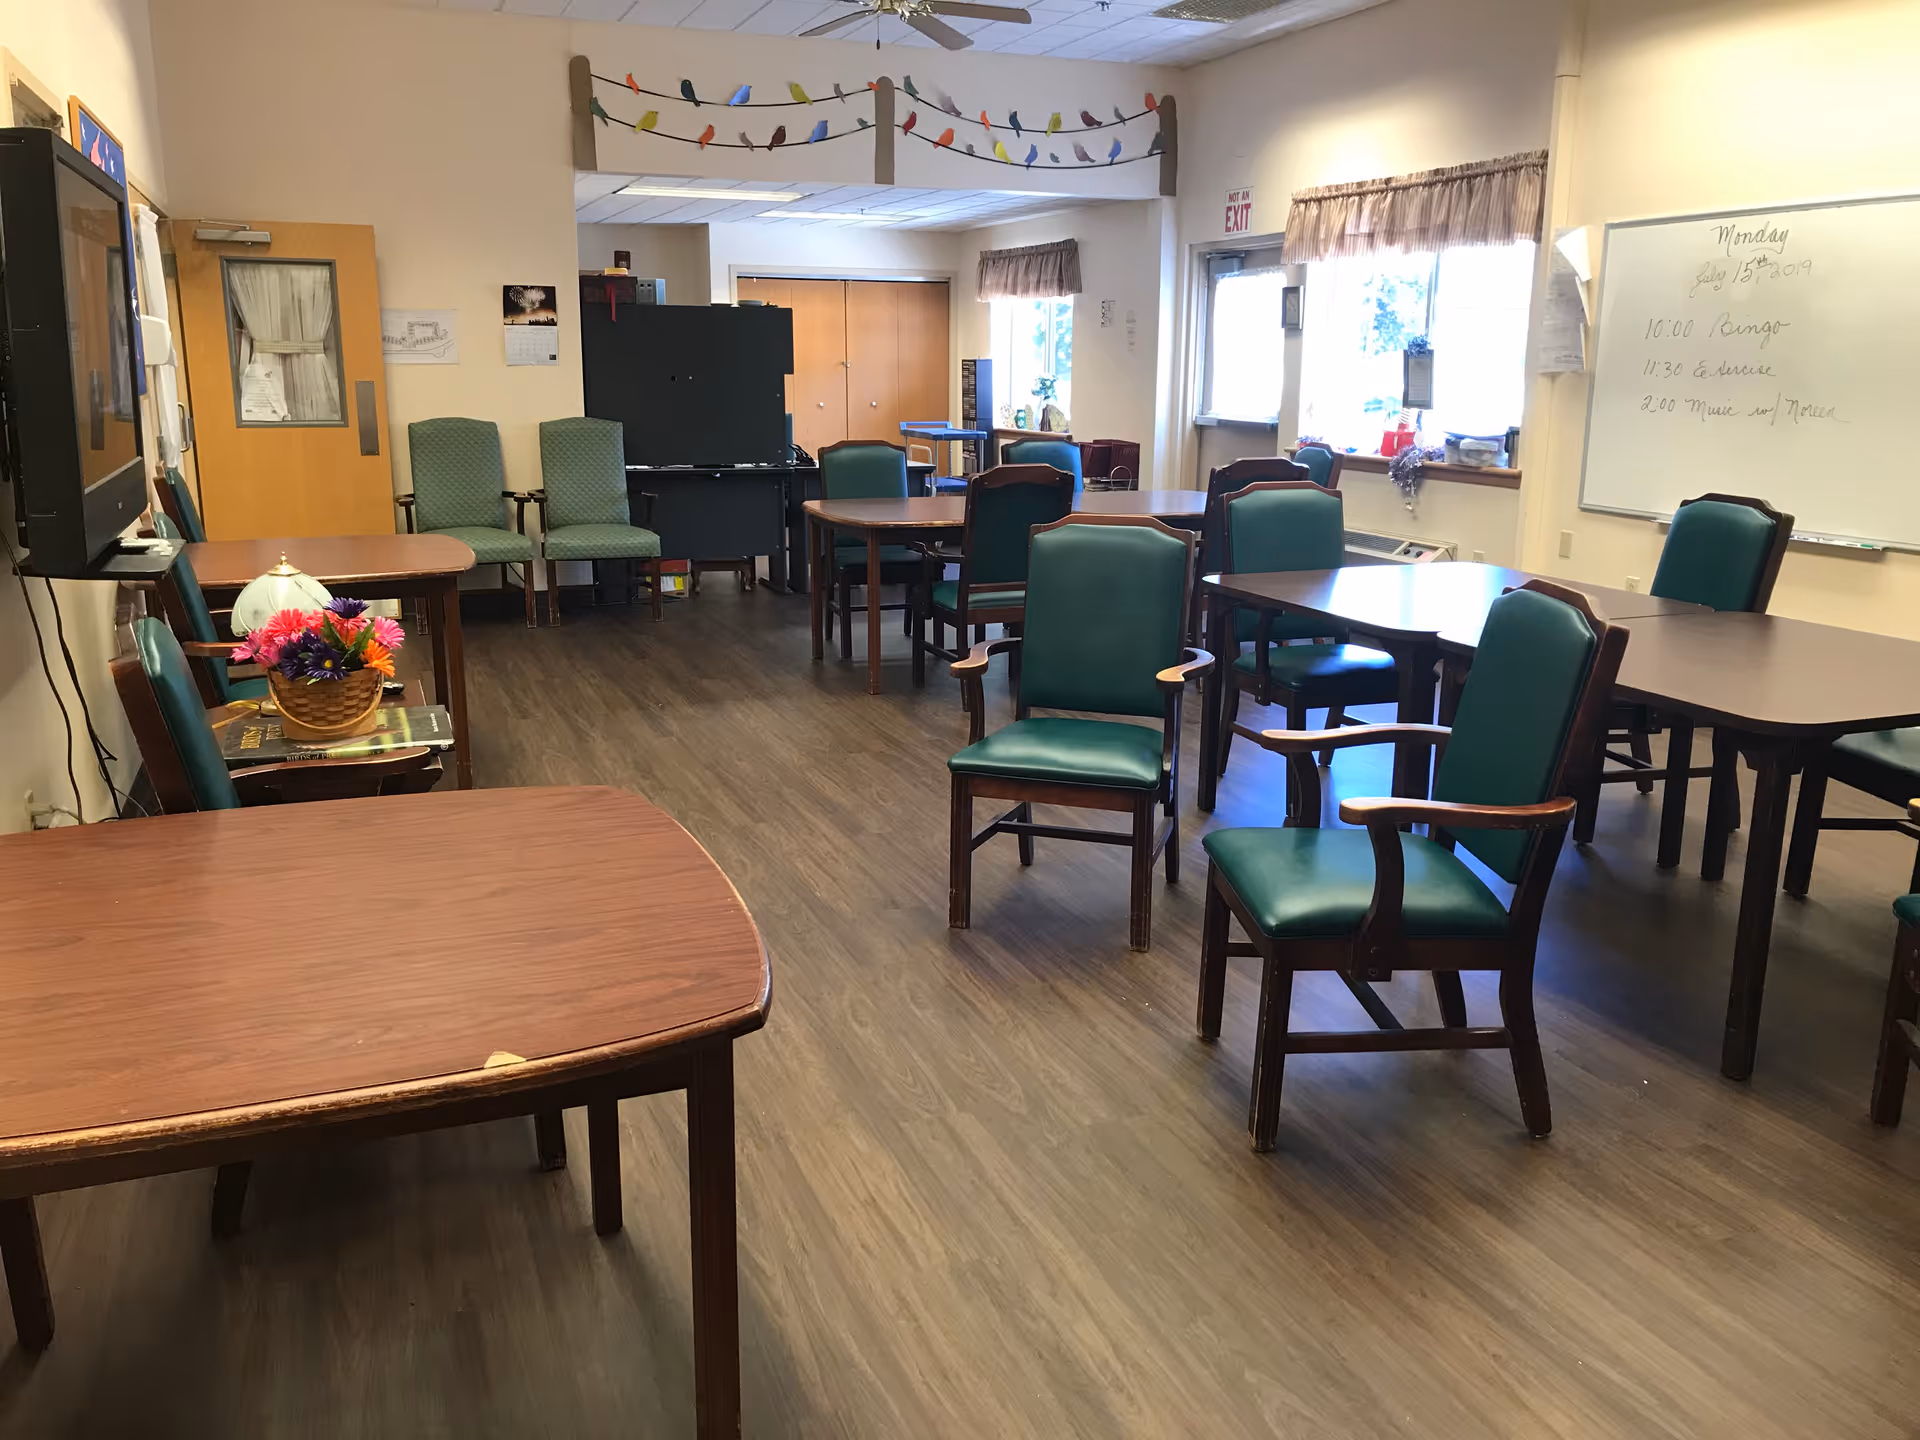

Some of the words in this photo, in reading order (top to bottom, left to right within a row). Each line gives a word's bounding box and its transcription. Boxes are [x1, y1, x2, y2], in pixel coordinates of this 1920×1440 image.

[1228, 192, 1240, 203] NOT
[1242, 190, 1250, 201] AN
[1225, 203, 1251, 233] EXIT
[1709, 221, 1789, 257] Monday
[1769, 259, 1812, 279] 2019
[1645, 318, 1694, 339] 10:00
[1709, 312, 1791, 349] Bingo
[1643, 359, 1683, 378] 11:30
[1640, 395, 1676, 413] 2:00
[1684, 398, 1740, 422] Music
